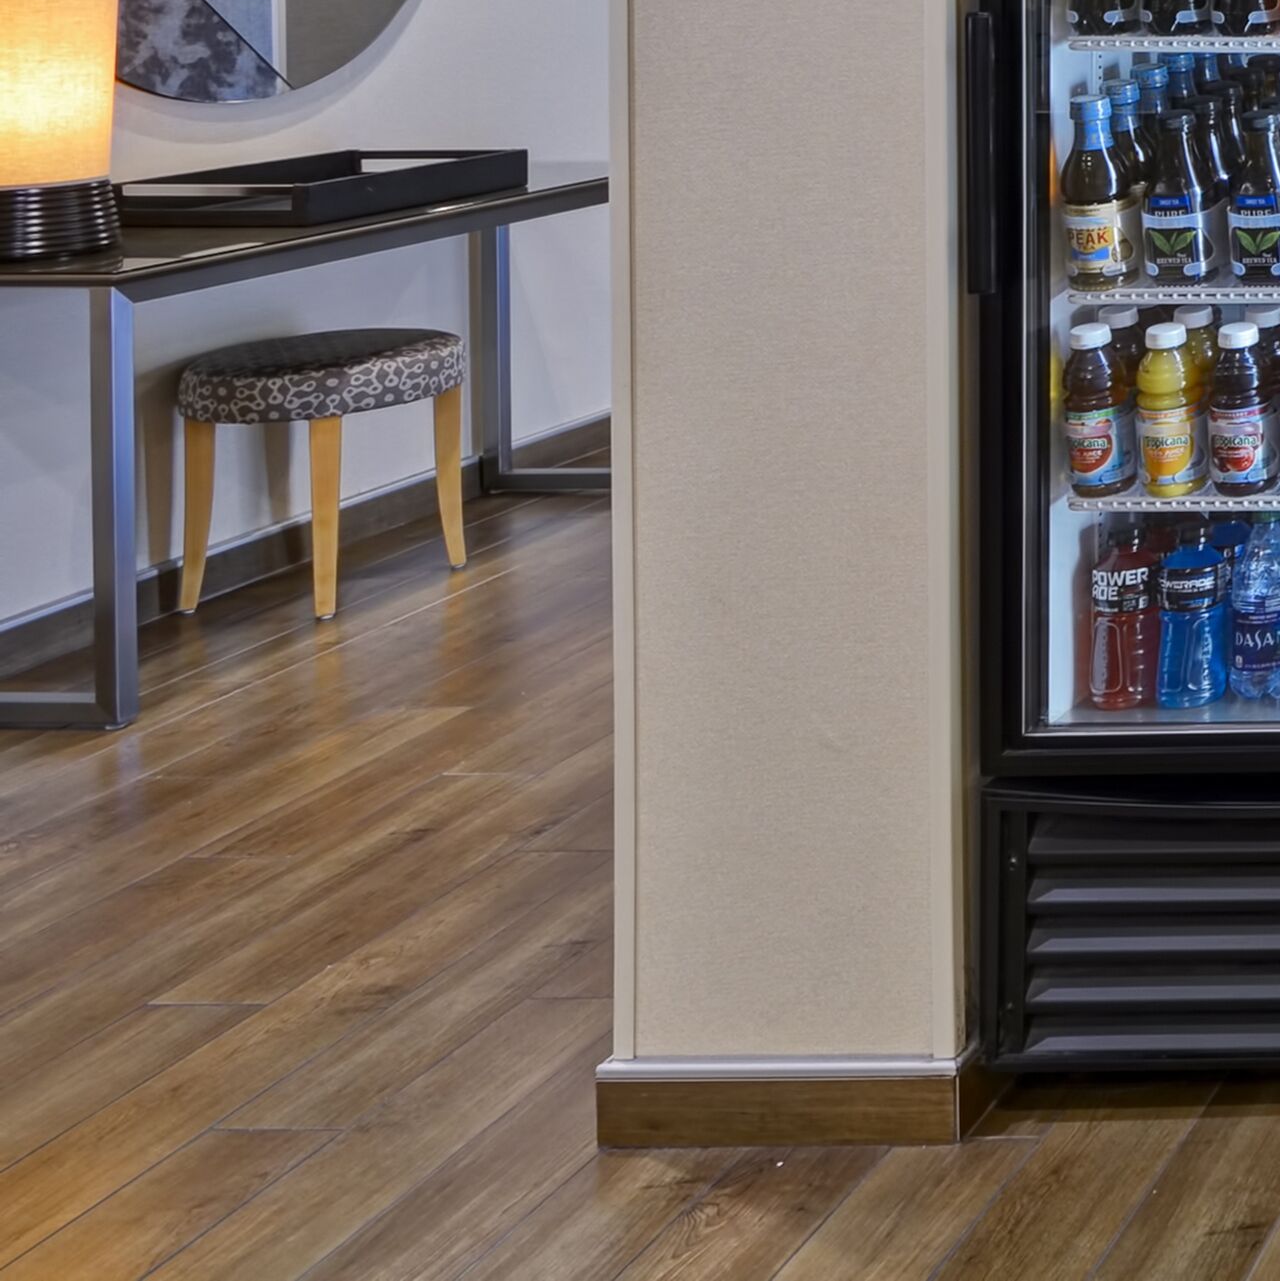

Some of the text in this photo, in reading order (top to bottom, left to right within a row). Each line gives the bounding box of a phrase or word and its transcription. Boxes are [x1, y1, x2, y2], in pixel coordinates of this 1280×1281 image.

[1068, 231, 1109, 245] PEAK
[1145, 436, 1188, 449] Tropicana
[1092, 567, 1148, 586] POWER
